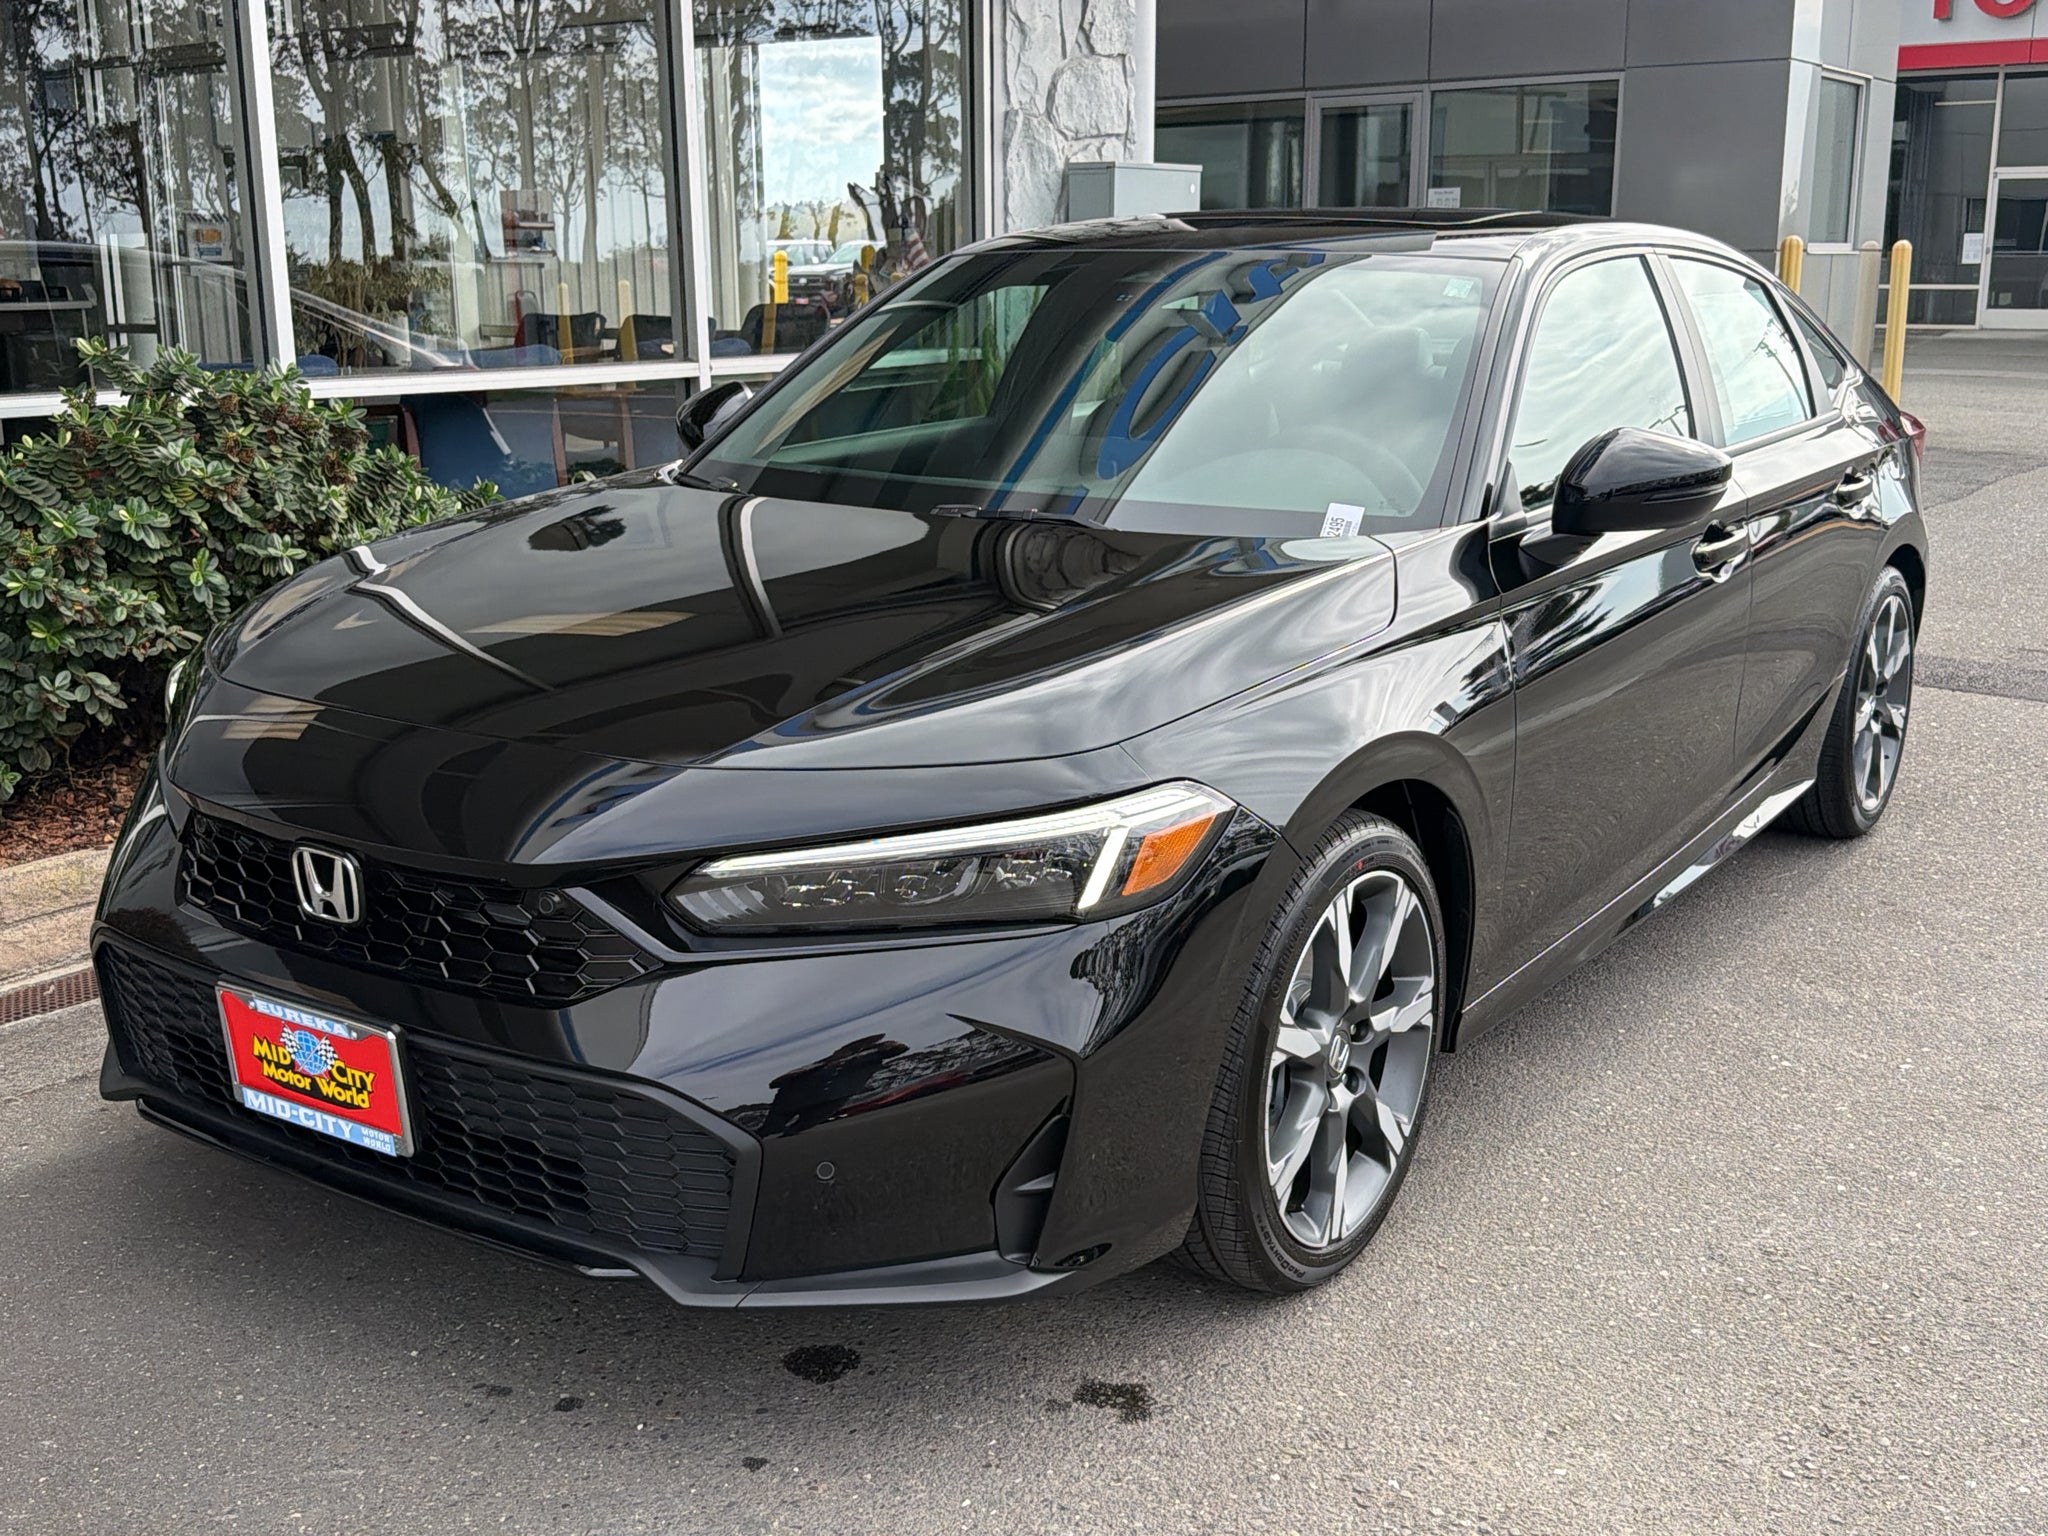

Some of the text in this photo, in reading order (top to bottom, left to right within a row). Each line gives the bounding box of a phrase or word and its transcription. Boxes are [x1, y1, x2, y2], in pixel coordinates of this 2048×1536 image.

[1327, 517, 1344, 537] 2495
[256, 999, 348, 1038] EUREKA
[253, 1034, 376, 1092] MID CITY
[262, 1060, 370, 1109] Motor World
[246, 1089, 354, 1141] MID-CITY
[363, 1137, 392, 1151] WORLD
